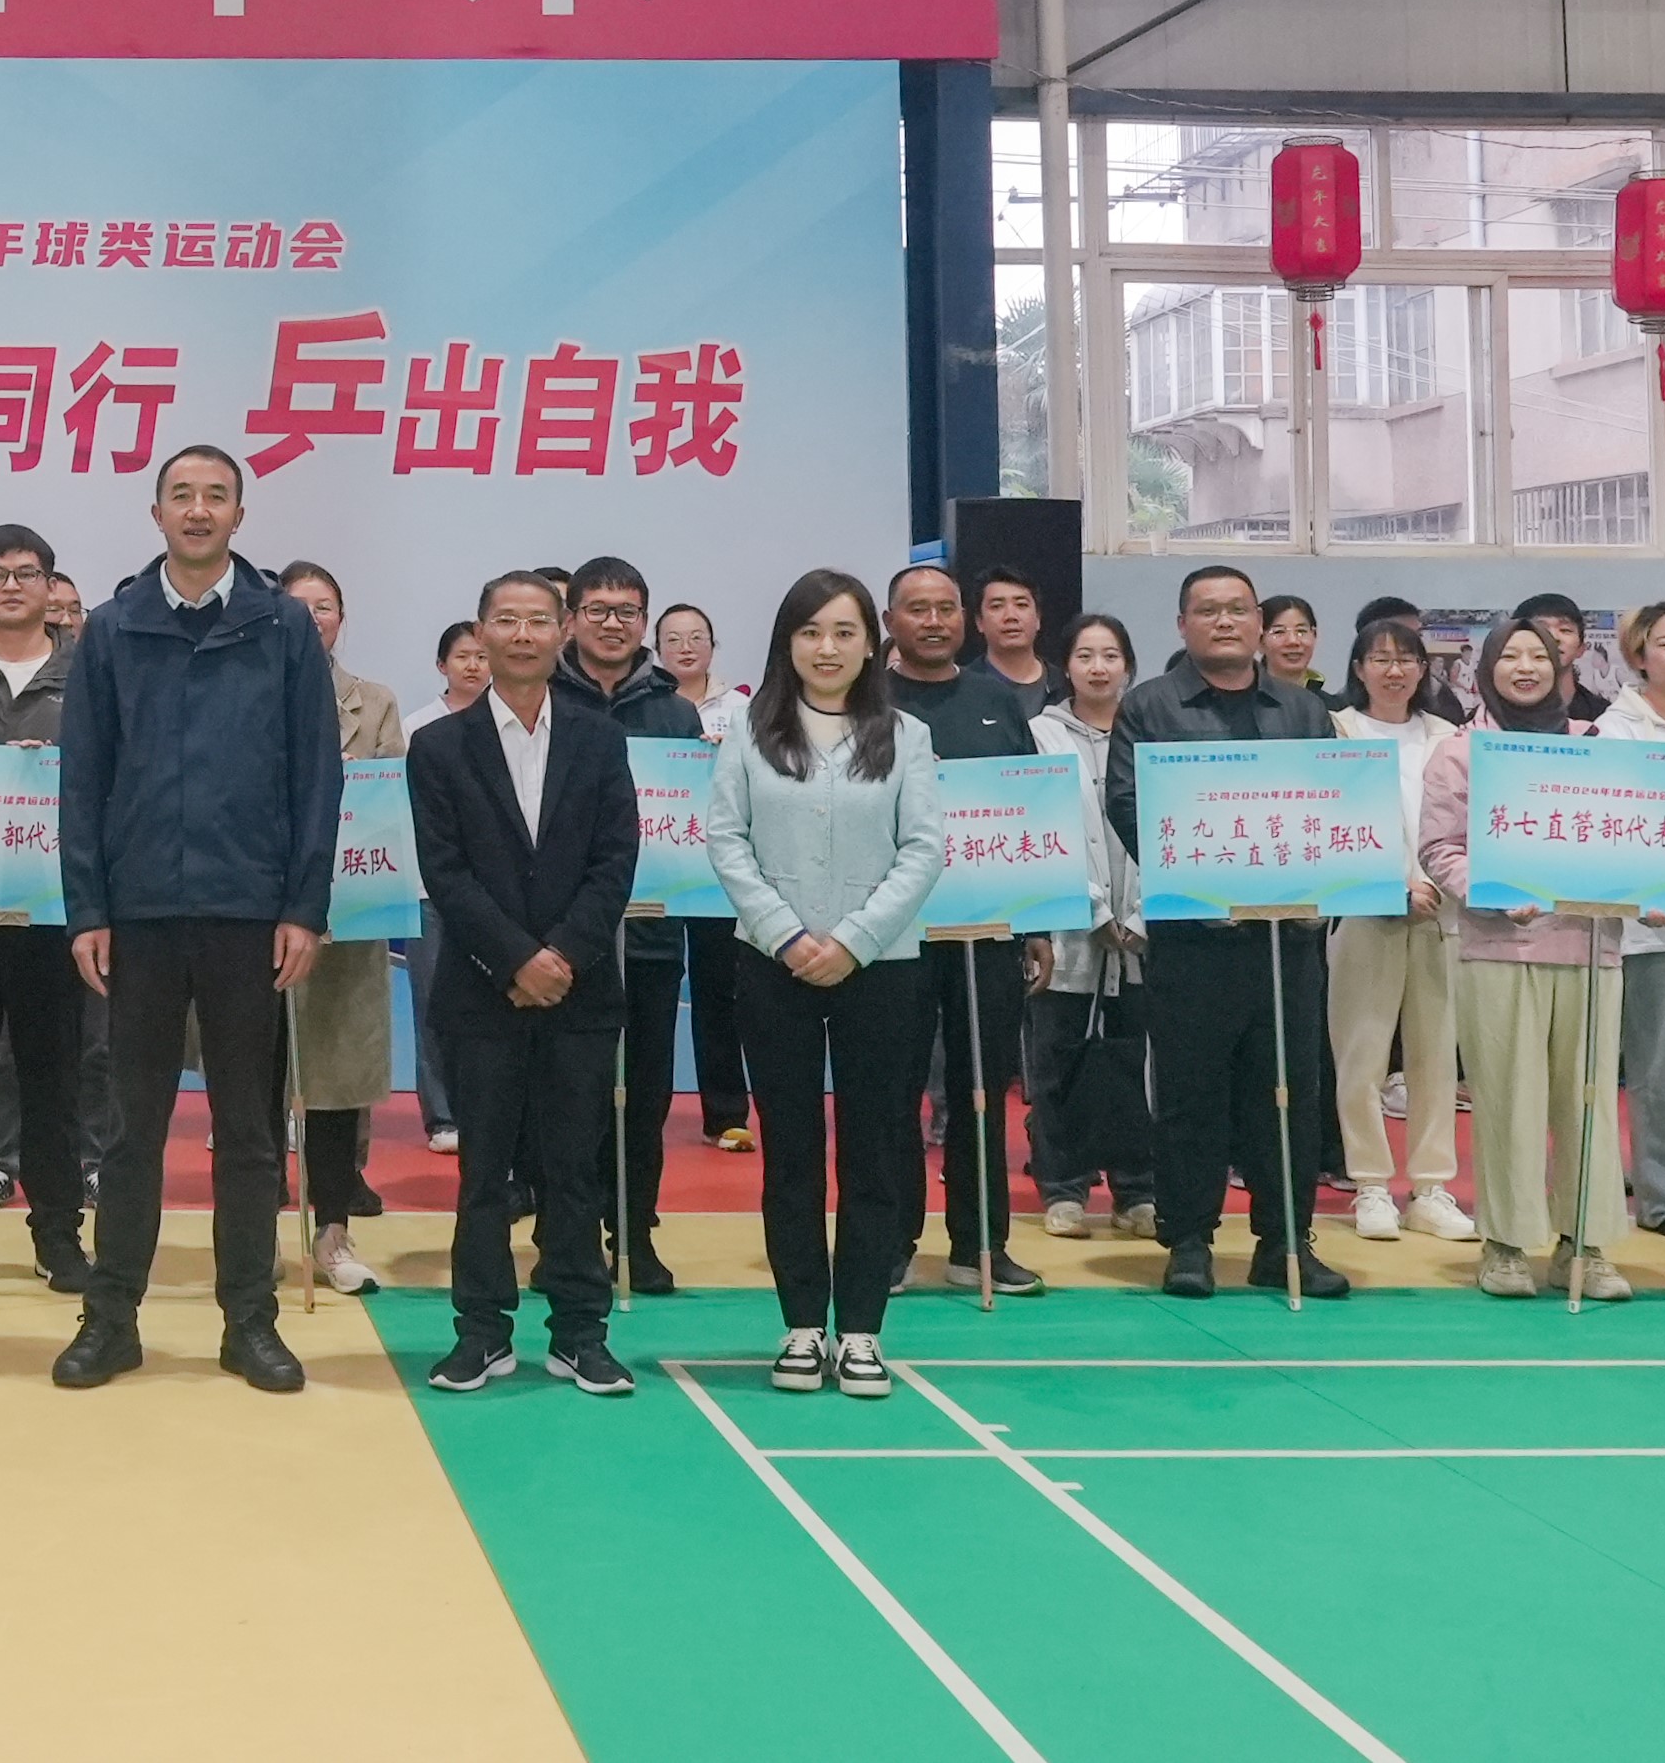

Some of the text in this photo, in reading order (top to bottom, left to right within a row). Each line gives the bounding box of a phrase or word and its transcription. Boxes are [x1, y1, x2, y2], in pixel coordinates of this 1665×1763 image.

[245, 311, 744, 478] 乒出自我
[1158, 813, 1322, 841] 第九直管部
[1328, 825, 1383, 853] 联队
[341, 847, 397, 877] 联队
[1159, 842, 1322, 870] 第十六直管部
